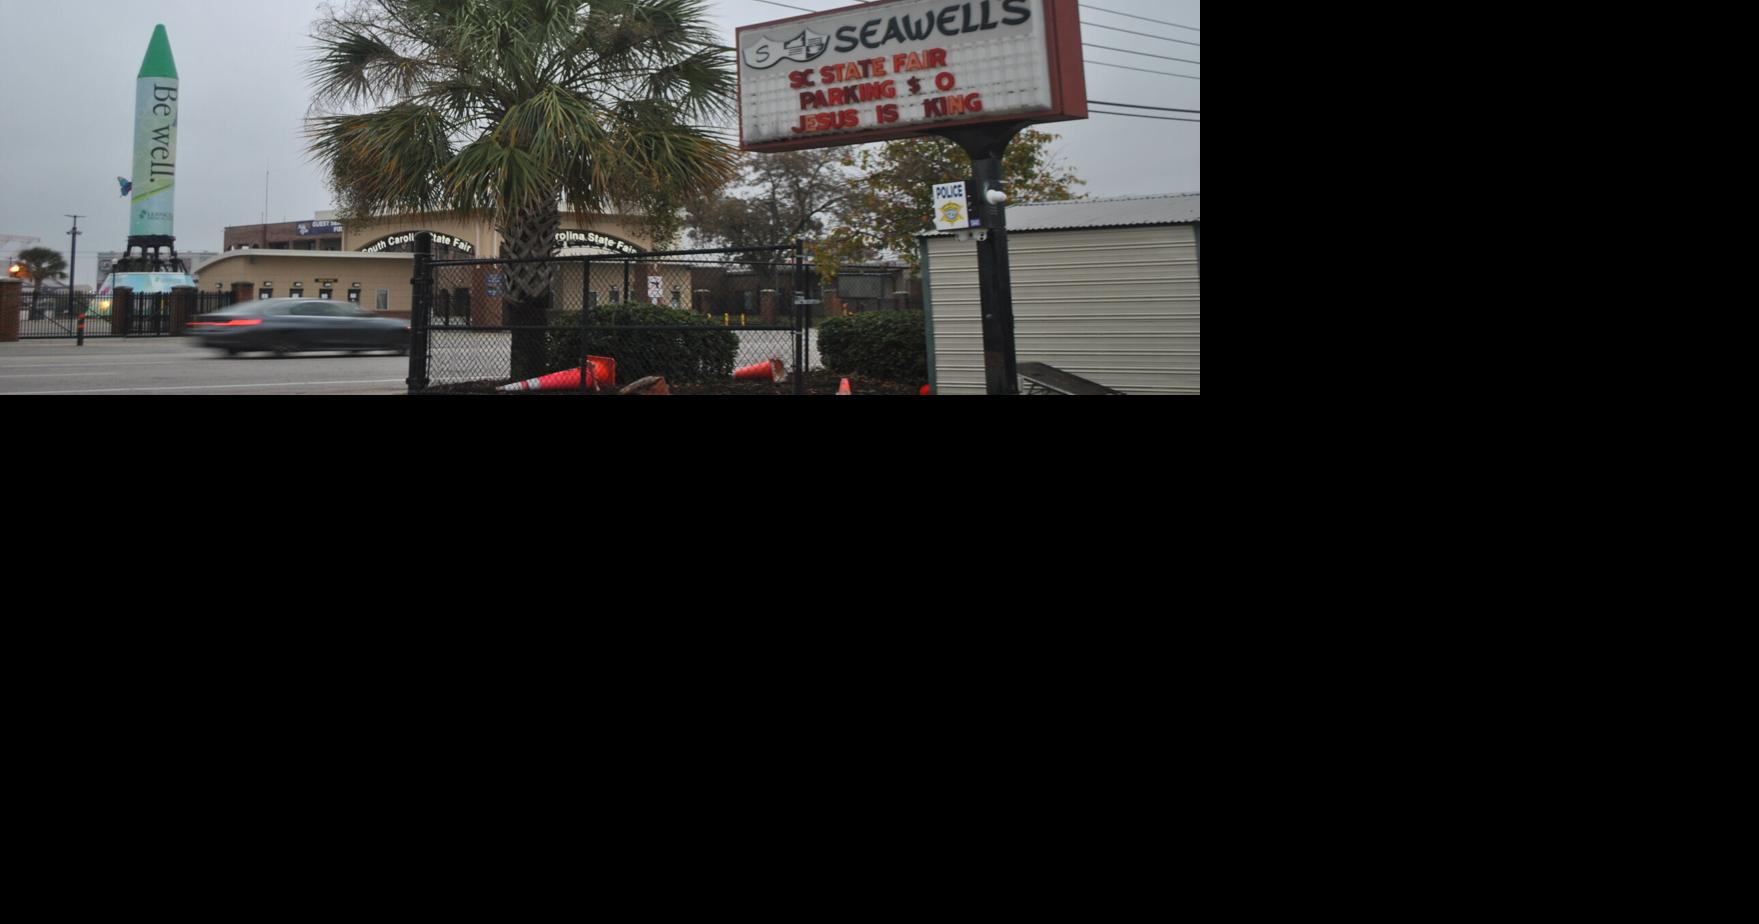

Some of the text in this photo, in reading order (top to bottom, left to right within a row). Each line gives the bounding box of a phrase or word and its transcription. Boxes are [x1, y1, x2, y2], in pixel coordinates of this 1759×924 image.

[788, 48, 947, 90] SC STATE FAIR
[152, 83, 177, 116] Be
[800, 80, 896, 110] PARKING
[791, 92, 983, 133] JESUS IS KING
[150, 124, 175, 182] well.
[936, 184, 963, 199] POLICE
[387, 232, 415, 246] Caroli
[431, 232, 451, 245] tate
[453, 238, 473, 253] Fair
[555, 230, 585, 242] rolina
[587, 232, 616, 247] State
